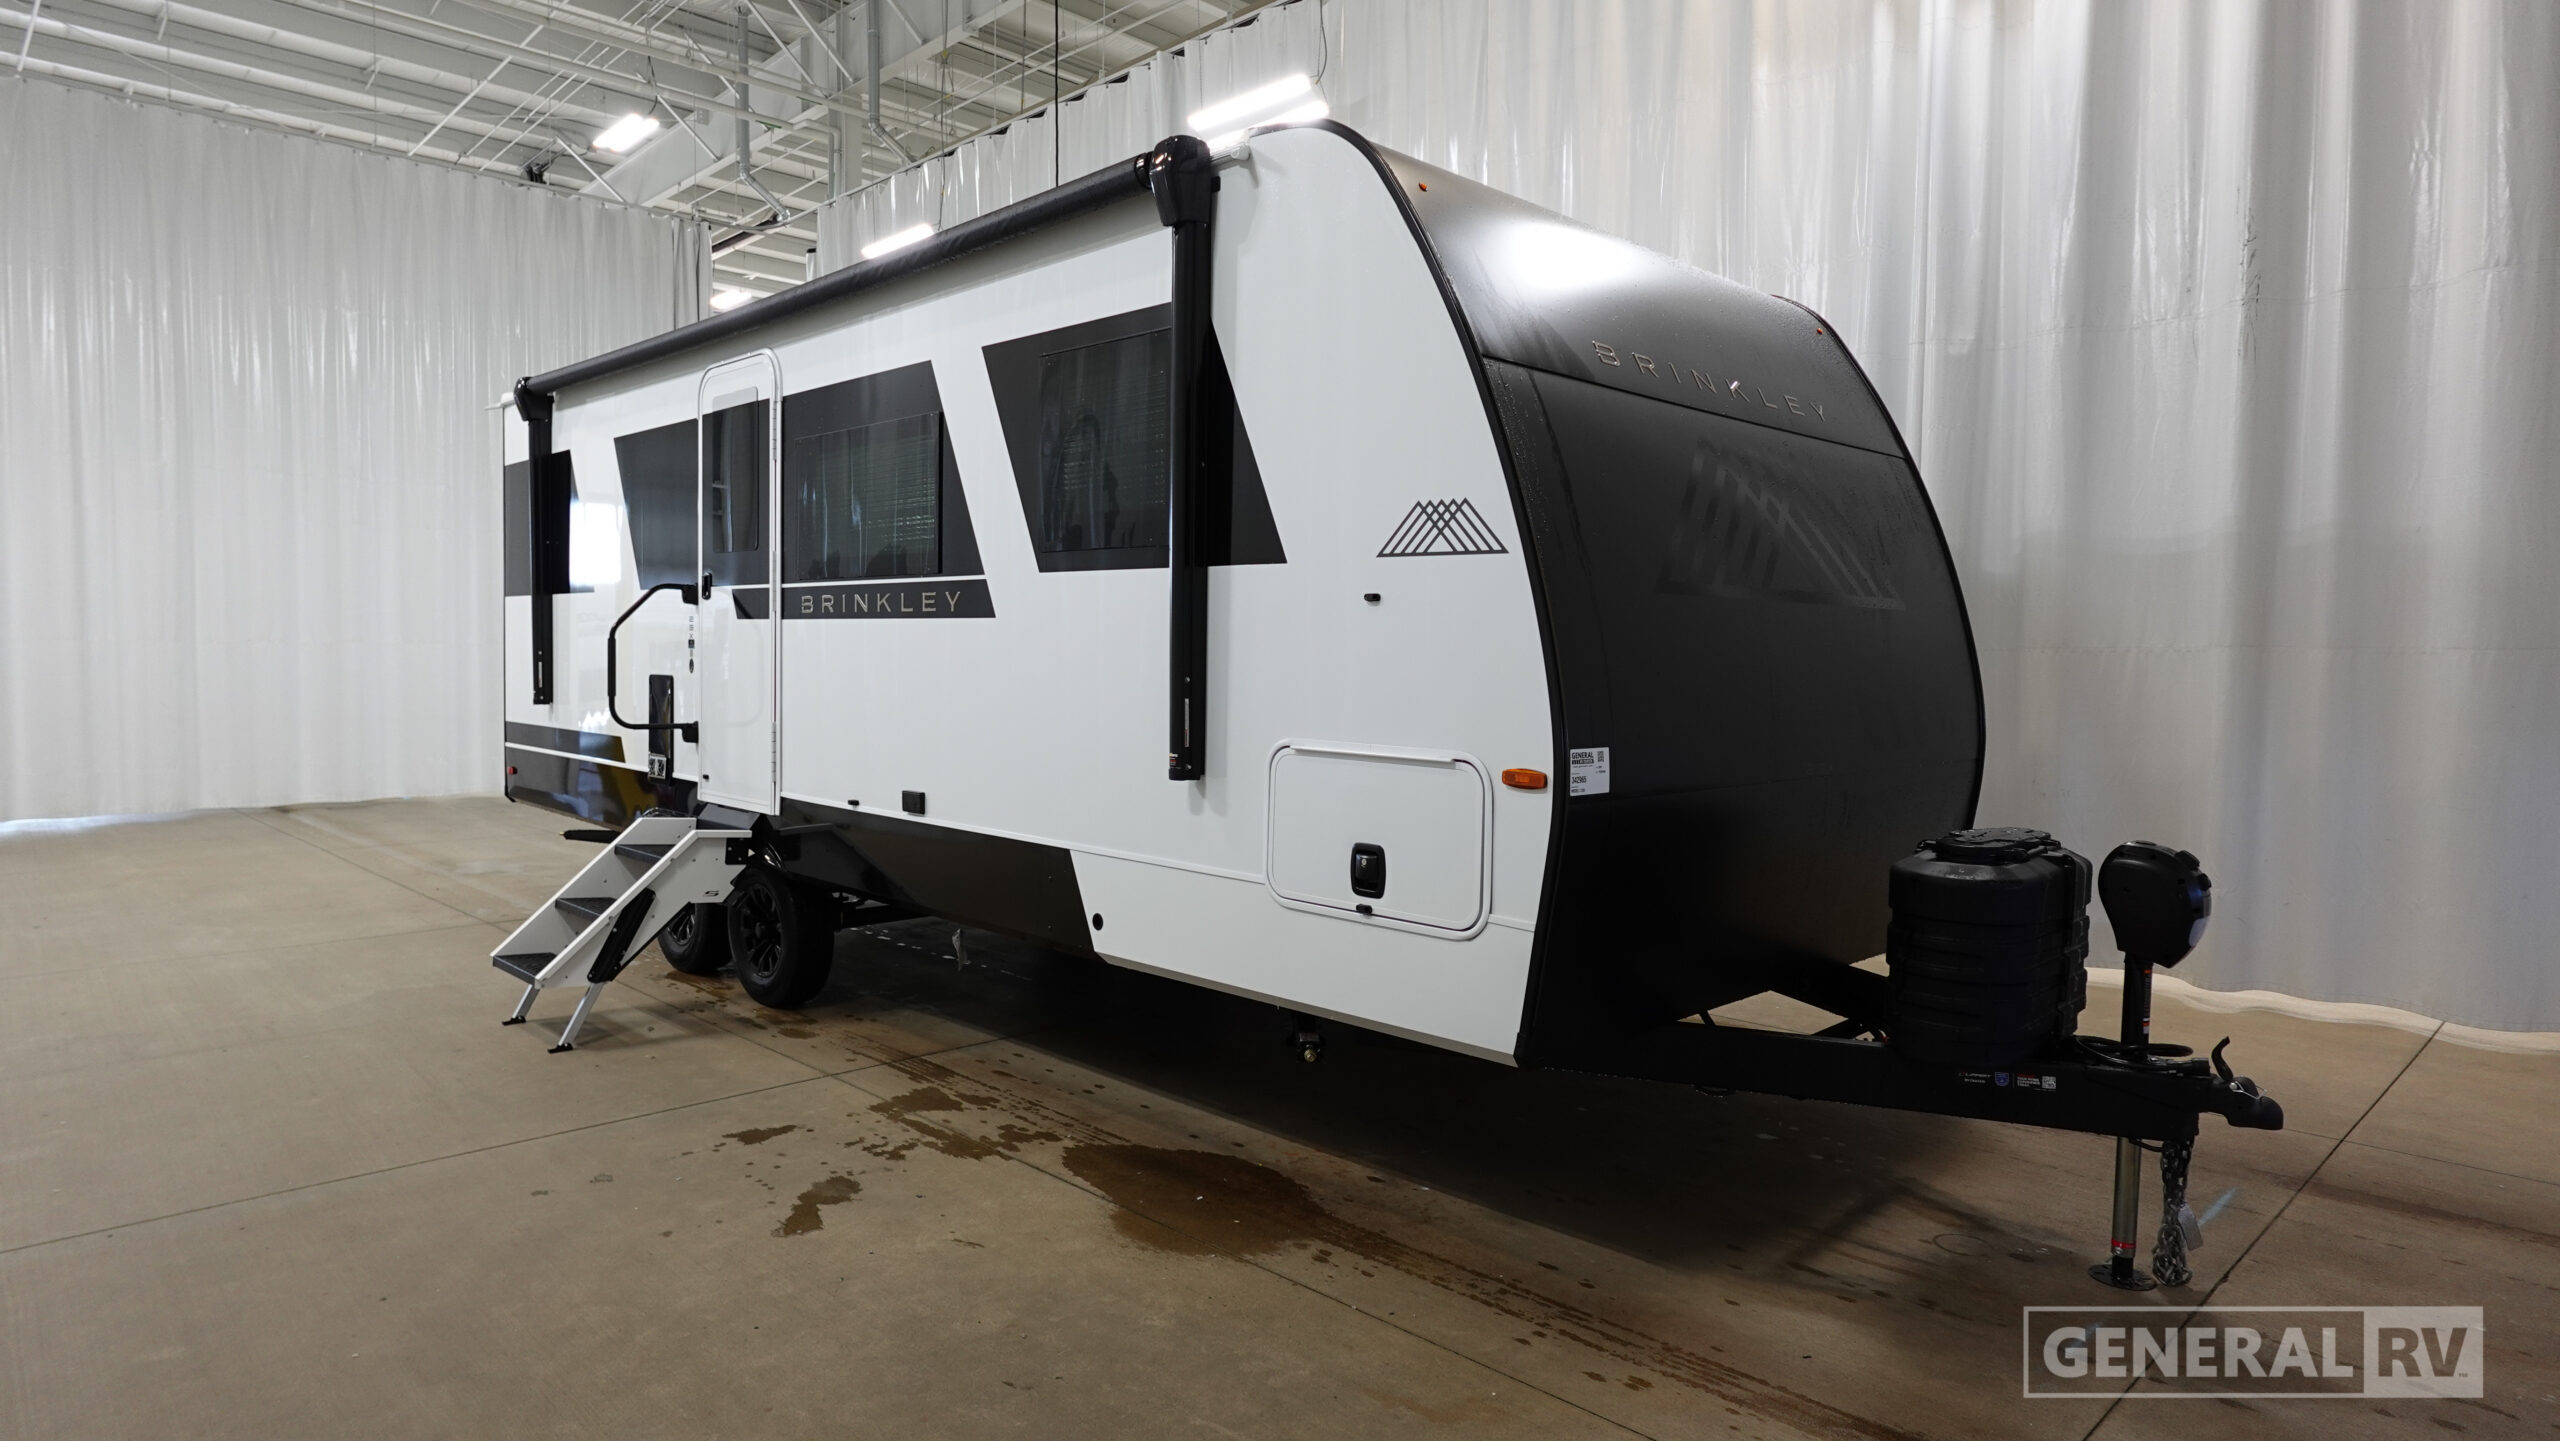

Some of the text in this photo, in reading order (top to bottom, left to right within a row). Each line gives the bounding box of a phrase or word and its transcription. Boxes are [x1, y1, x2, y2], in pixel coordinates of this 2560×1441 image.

[1592, 340, 1826, 422] BRINKLEY
[801, 591, 961, 613] BRINKLEY
[1571, 751, 1594, 760] GENERAL
